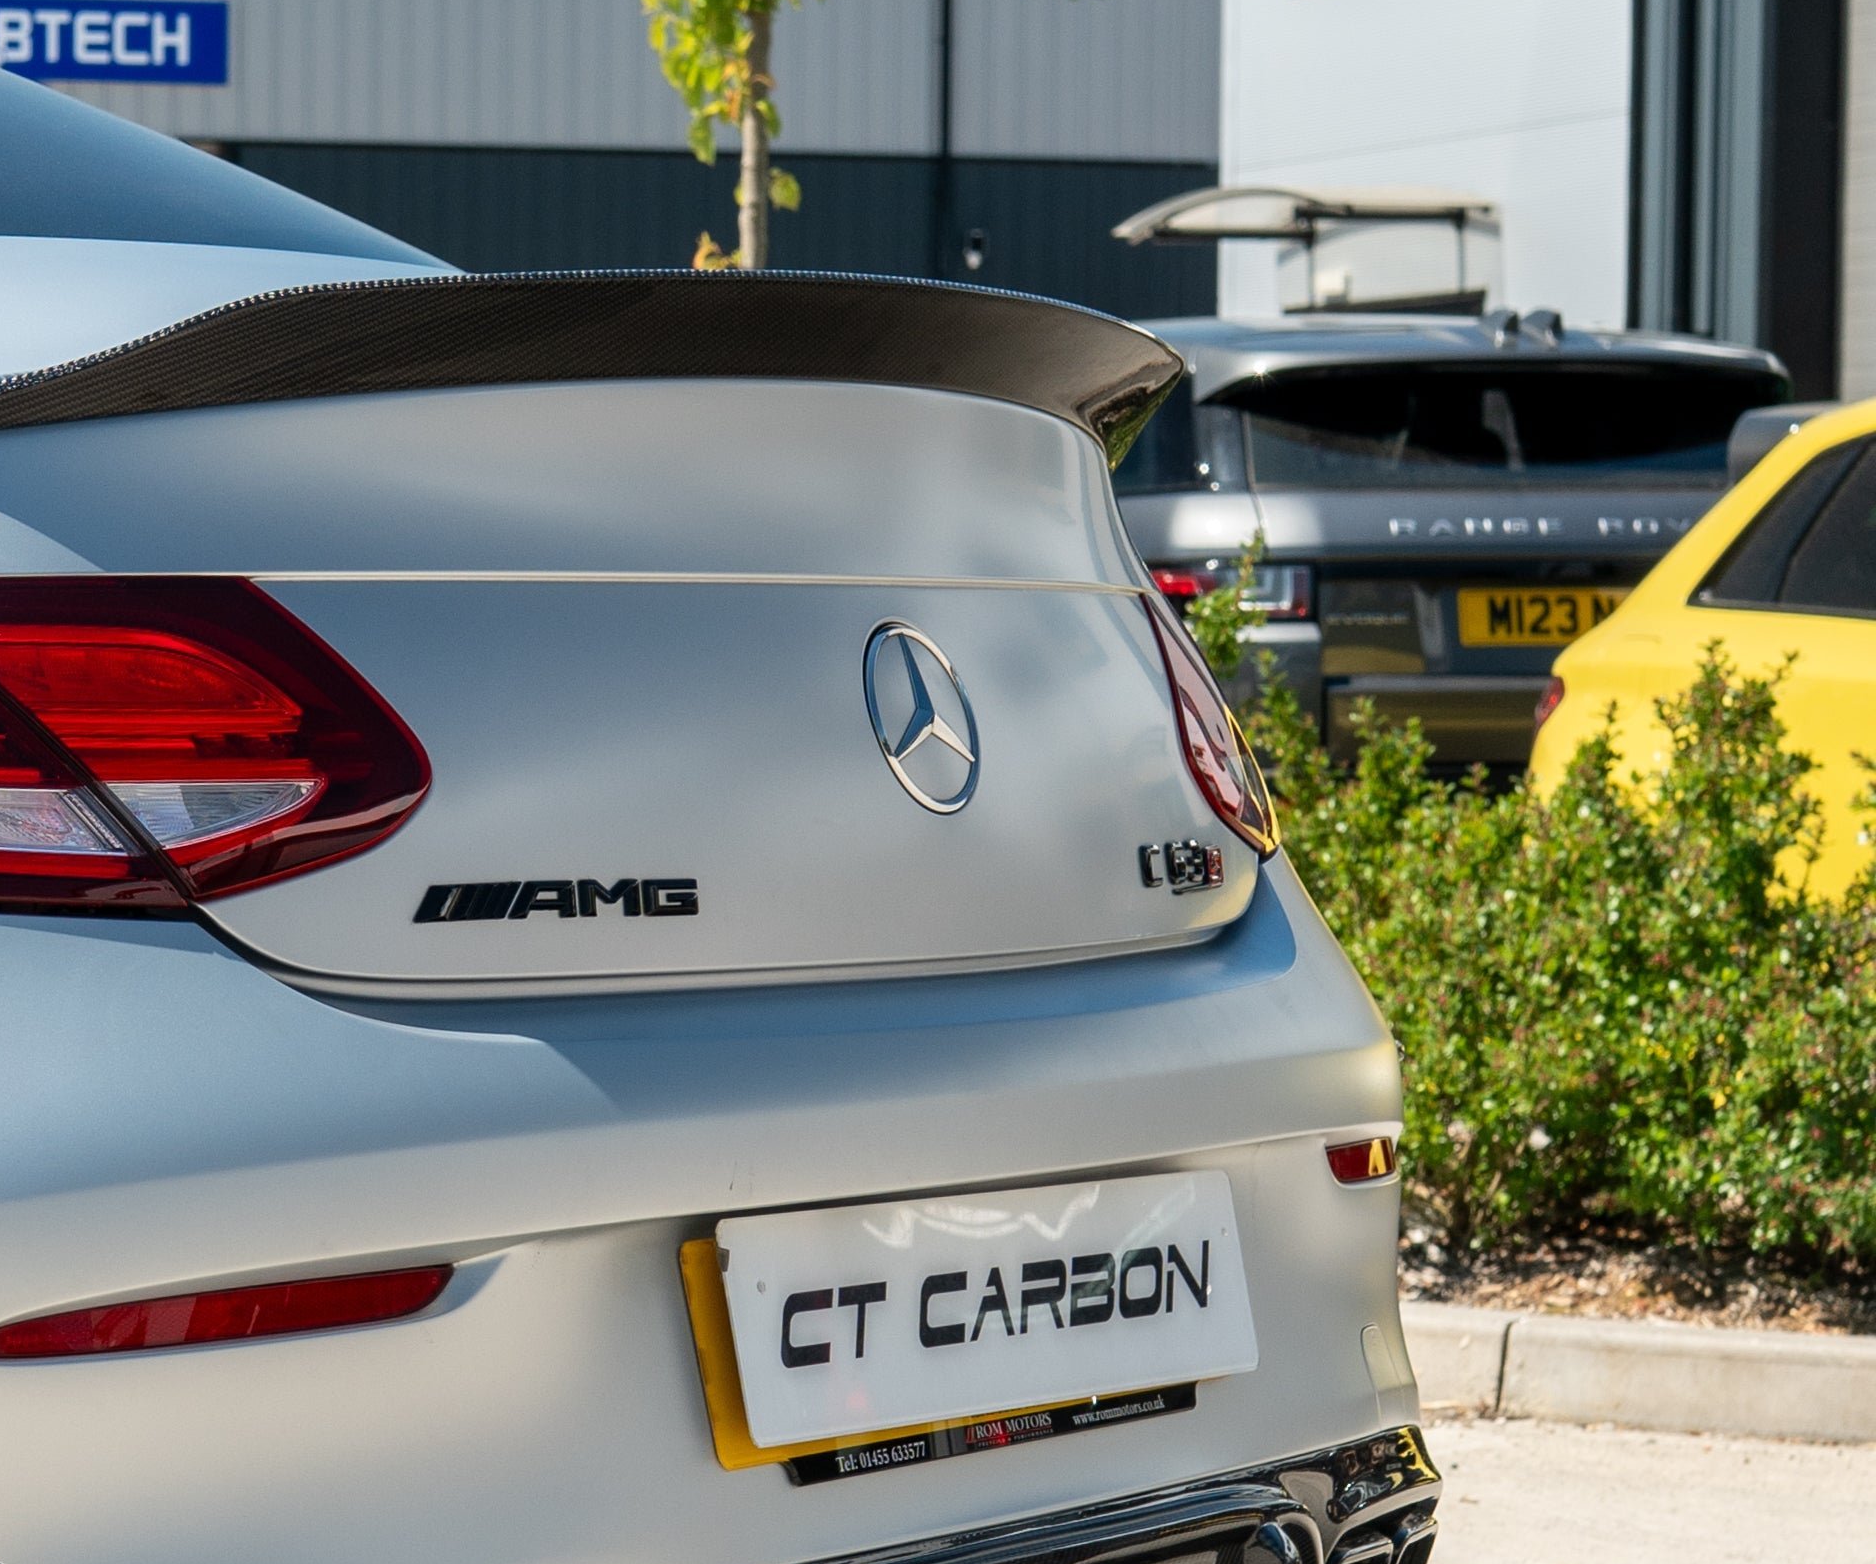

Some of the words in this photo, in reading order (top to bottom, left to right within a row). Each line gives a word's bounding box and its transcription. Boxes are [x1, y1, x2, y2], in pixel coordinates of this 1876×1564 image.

[1388, 516, 1564, 537] RANGE
[1487, 595, 1579, 636] M123
[781, 1281, 888, 1368] CT
[919, 1240, 1210, 1348] CARBON
[975, 1419, 1004, 1439] ROM
[1005, 1412, 1052, 1433] MOTORS
[1071, 1394, 1165, 1426] www.rommotors.co.uk
[835, 1453, 859, 1473] Tel:
[859, 1448, 890, 1469] 01455
[891, 1440, 925, 1464] 633577
